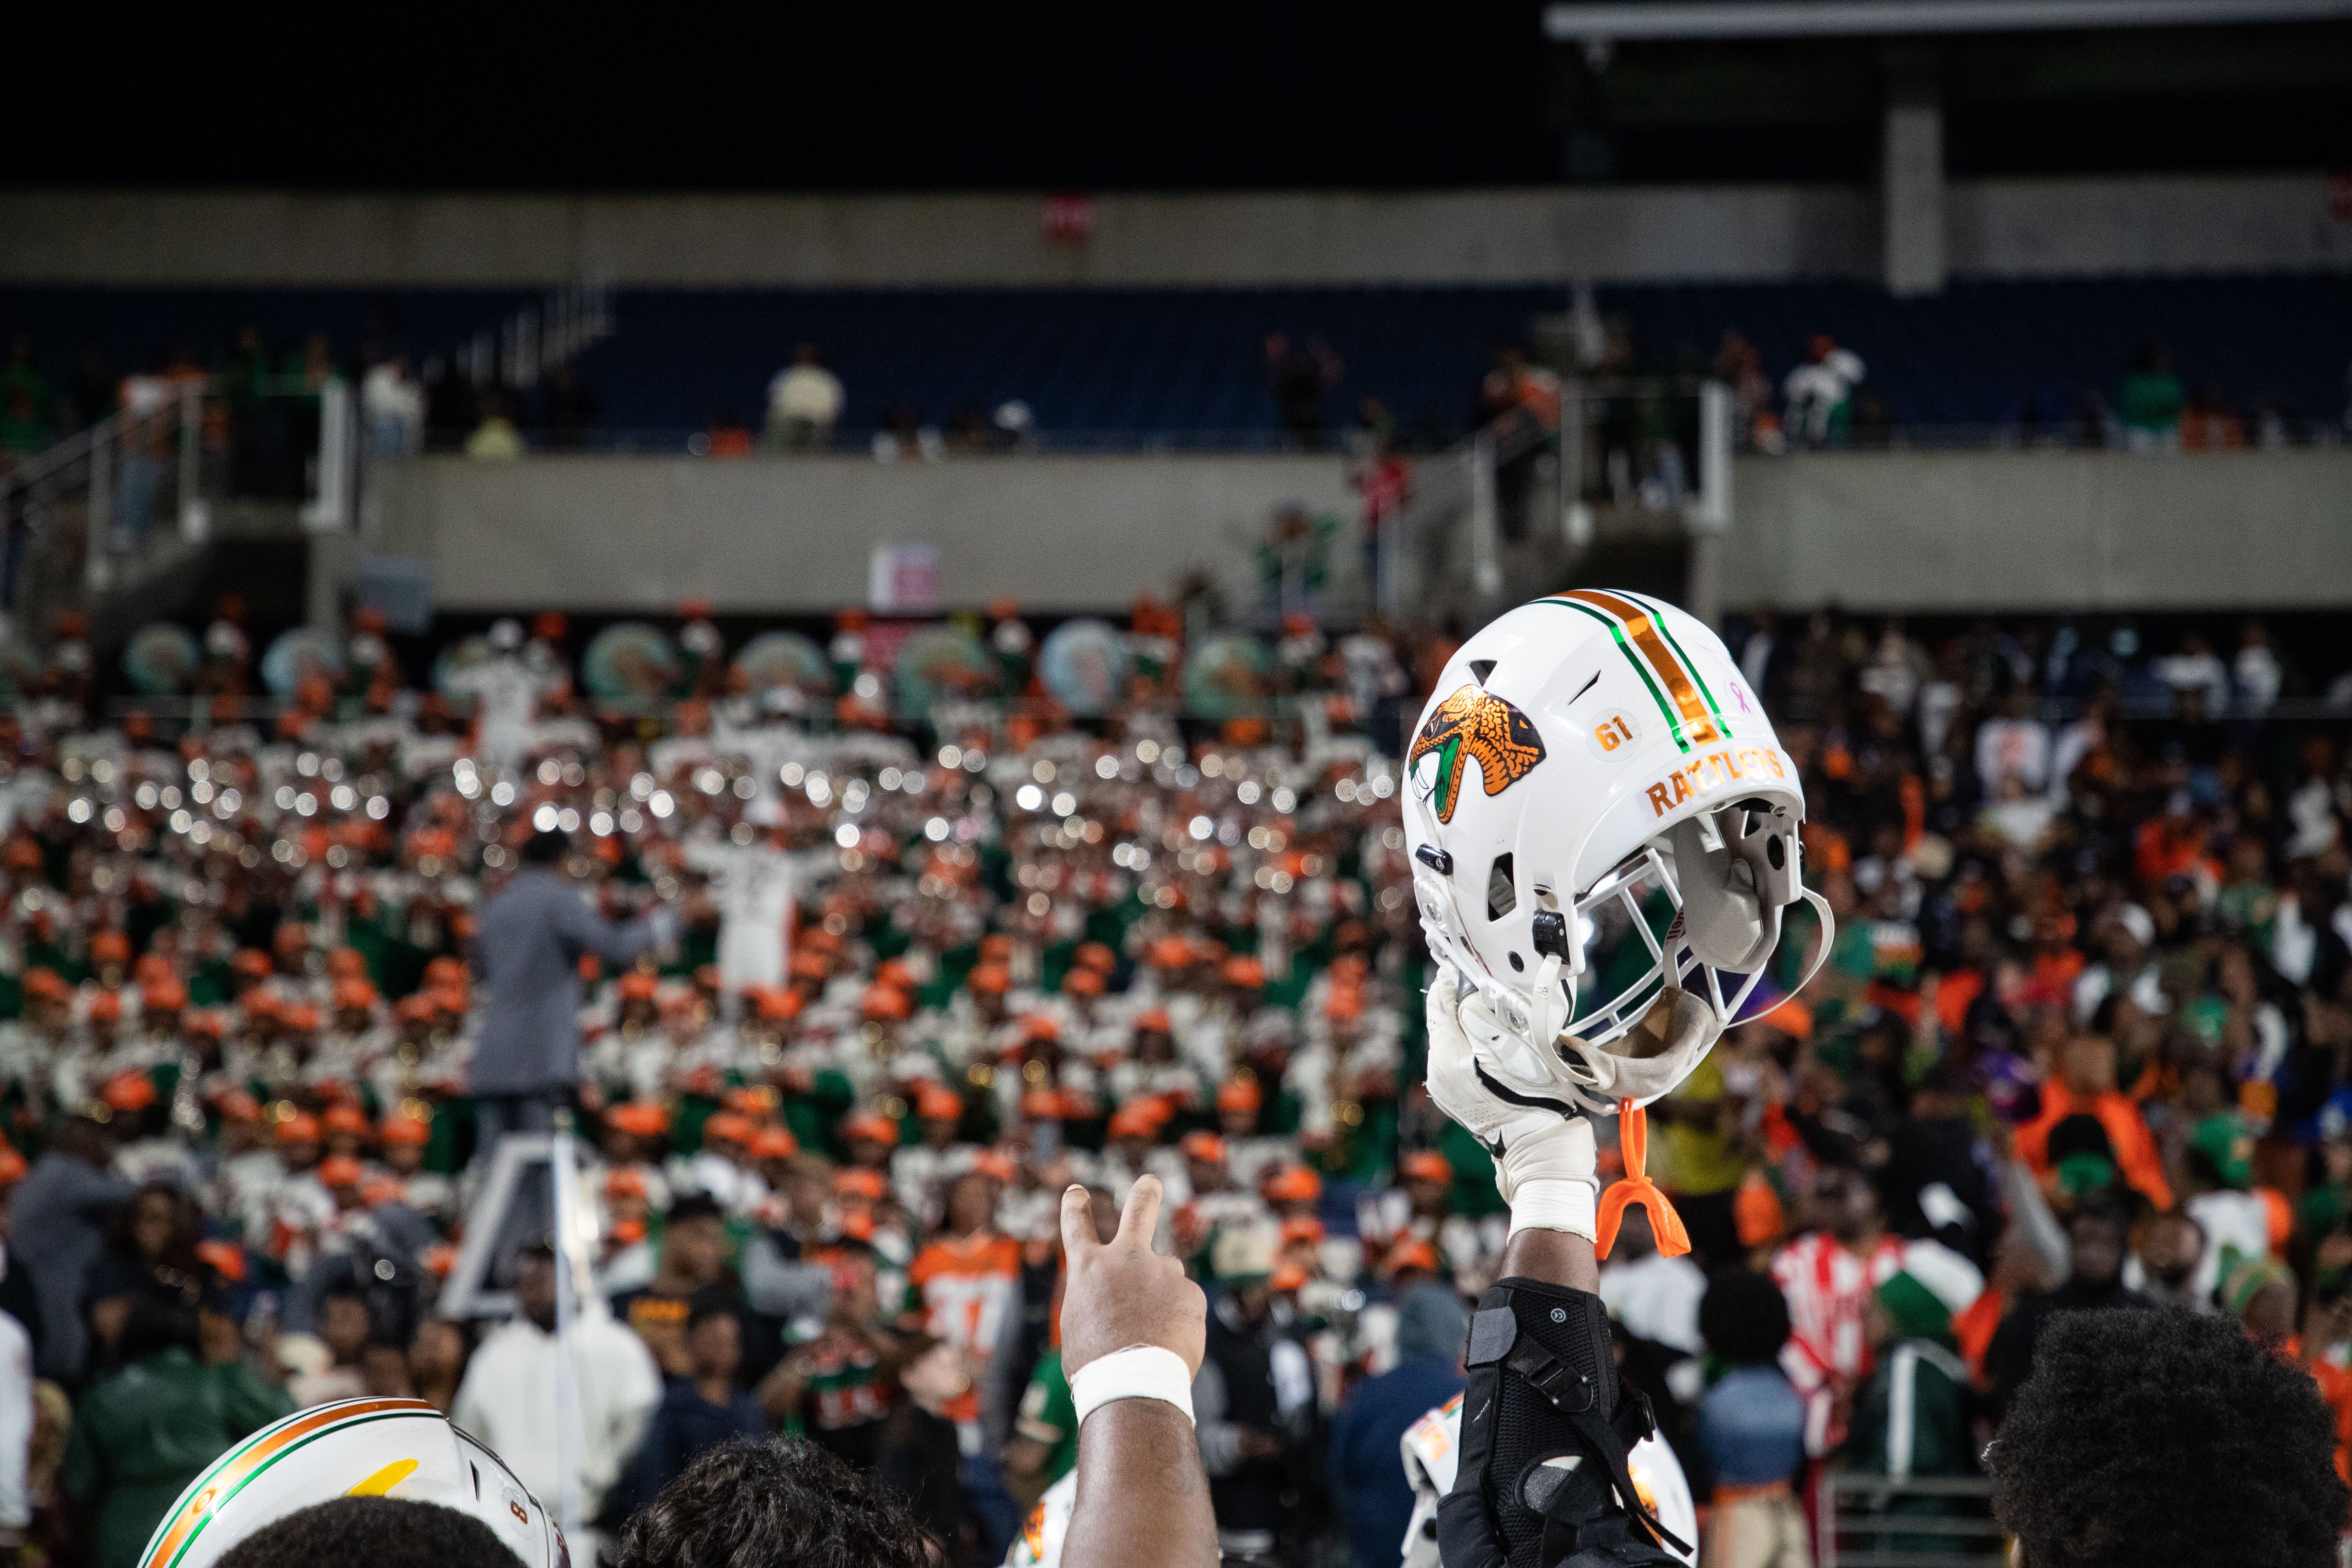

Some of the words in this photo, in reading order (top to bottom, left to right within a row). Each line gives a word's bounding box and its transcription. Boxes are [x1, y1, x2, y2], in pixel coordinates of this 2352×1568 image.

[1594, 715, 1633, 751] 61
[1645, 747, 1785, 818] RATTLERS
[510, 1500, 528, 1525] 8
